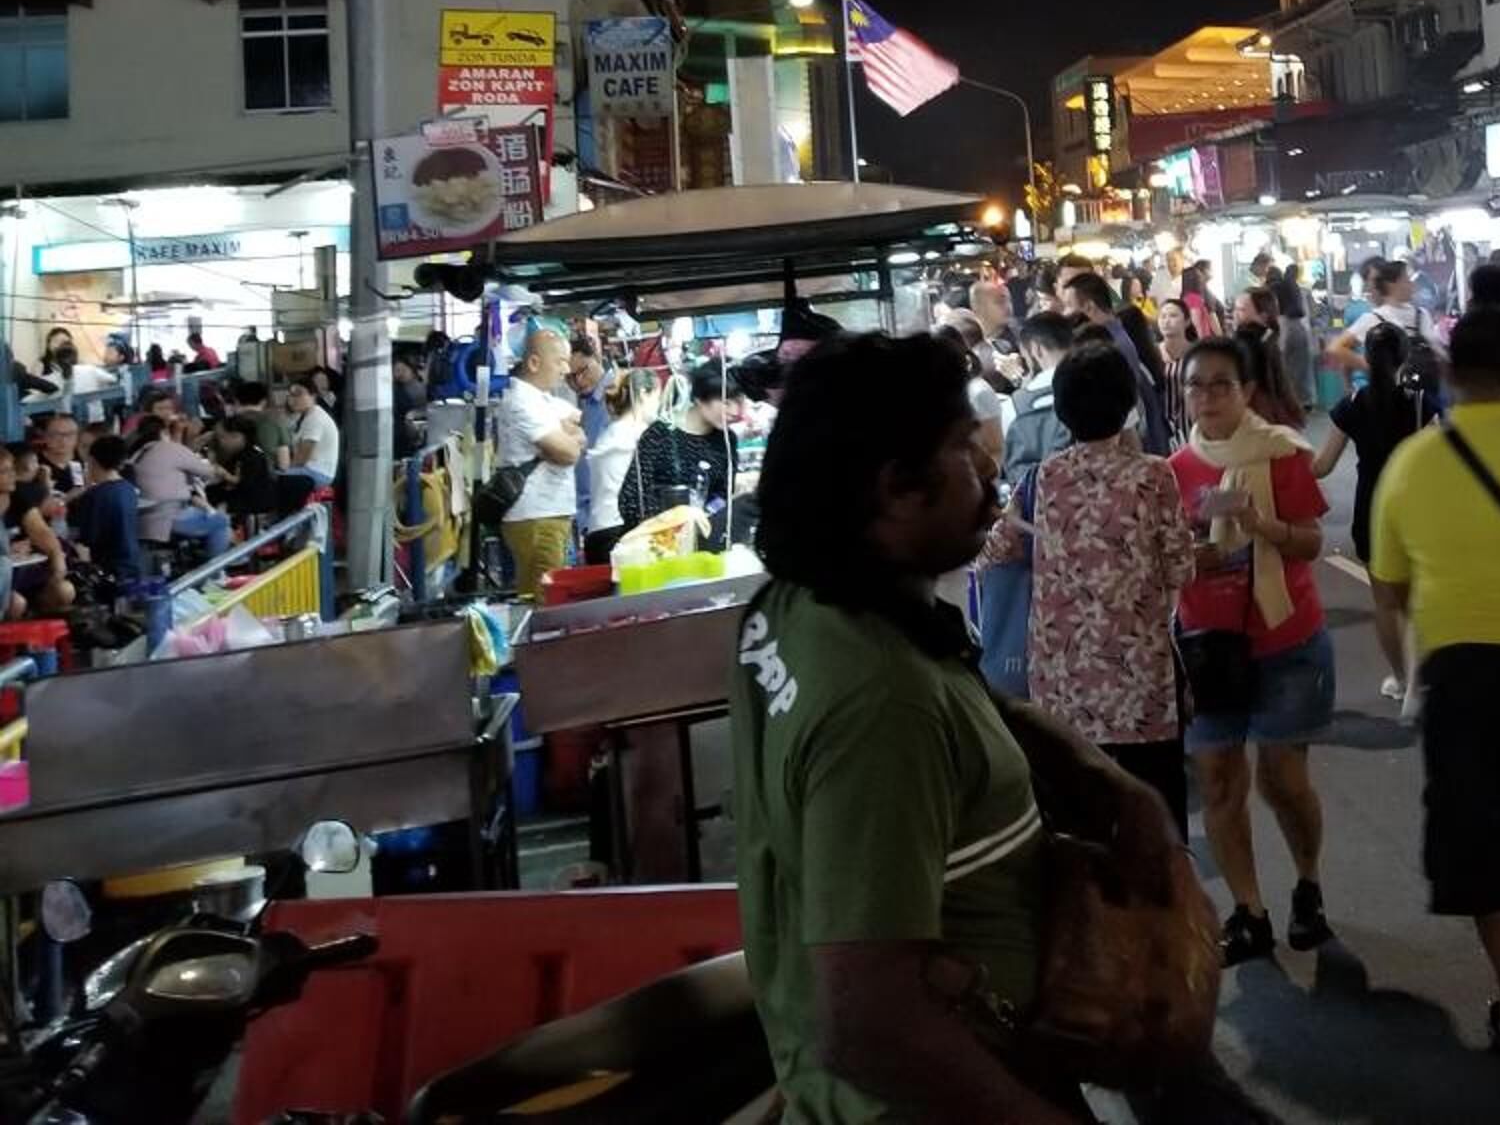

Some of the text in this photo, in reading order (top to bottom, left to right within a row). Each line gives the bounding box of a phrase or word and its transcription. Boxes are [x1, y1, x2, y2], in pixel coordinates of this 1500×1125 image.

[457, 51, 537, 64] ZON TUNDA
[594, 51, 667, 73] MAXIM
[458, 67, 535, 80] AMARAN
[447, 79, 545, 92] ZON KAPIT
[603, 76, 660, 97] CAFE
[471, 91, 520, 104] RODA
[185, 240, 241, 257] MAXIM
